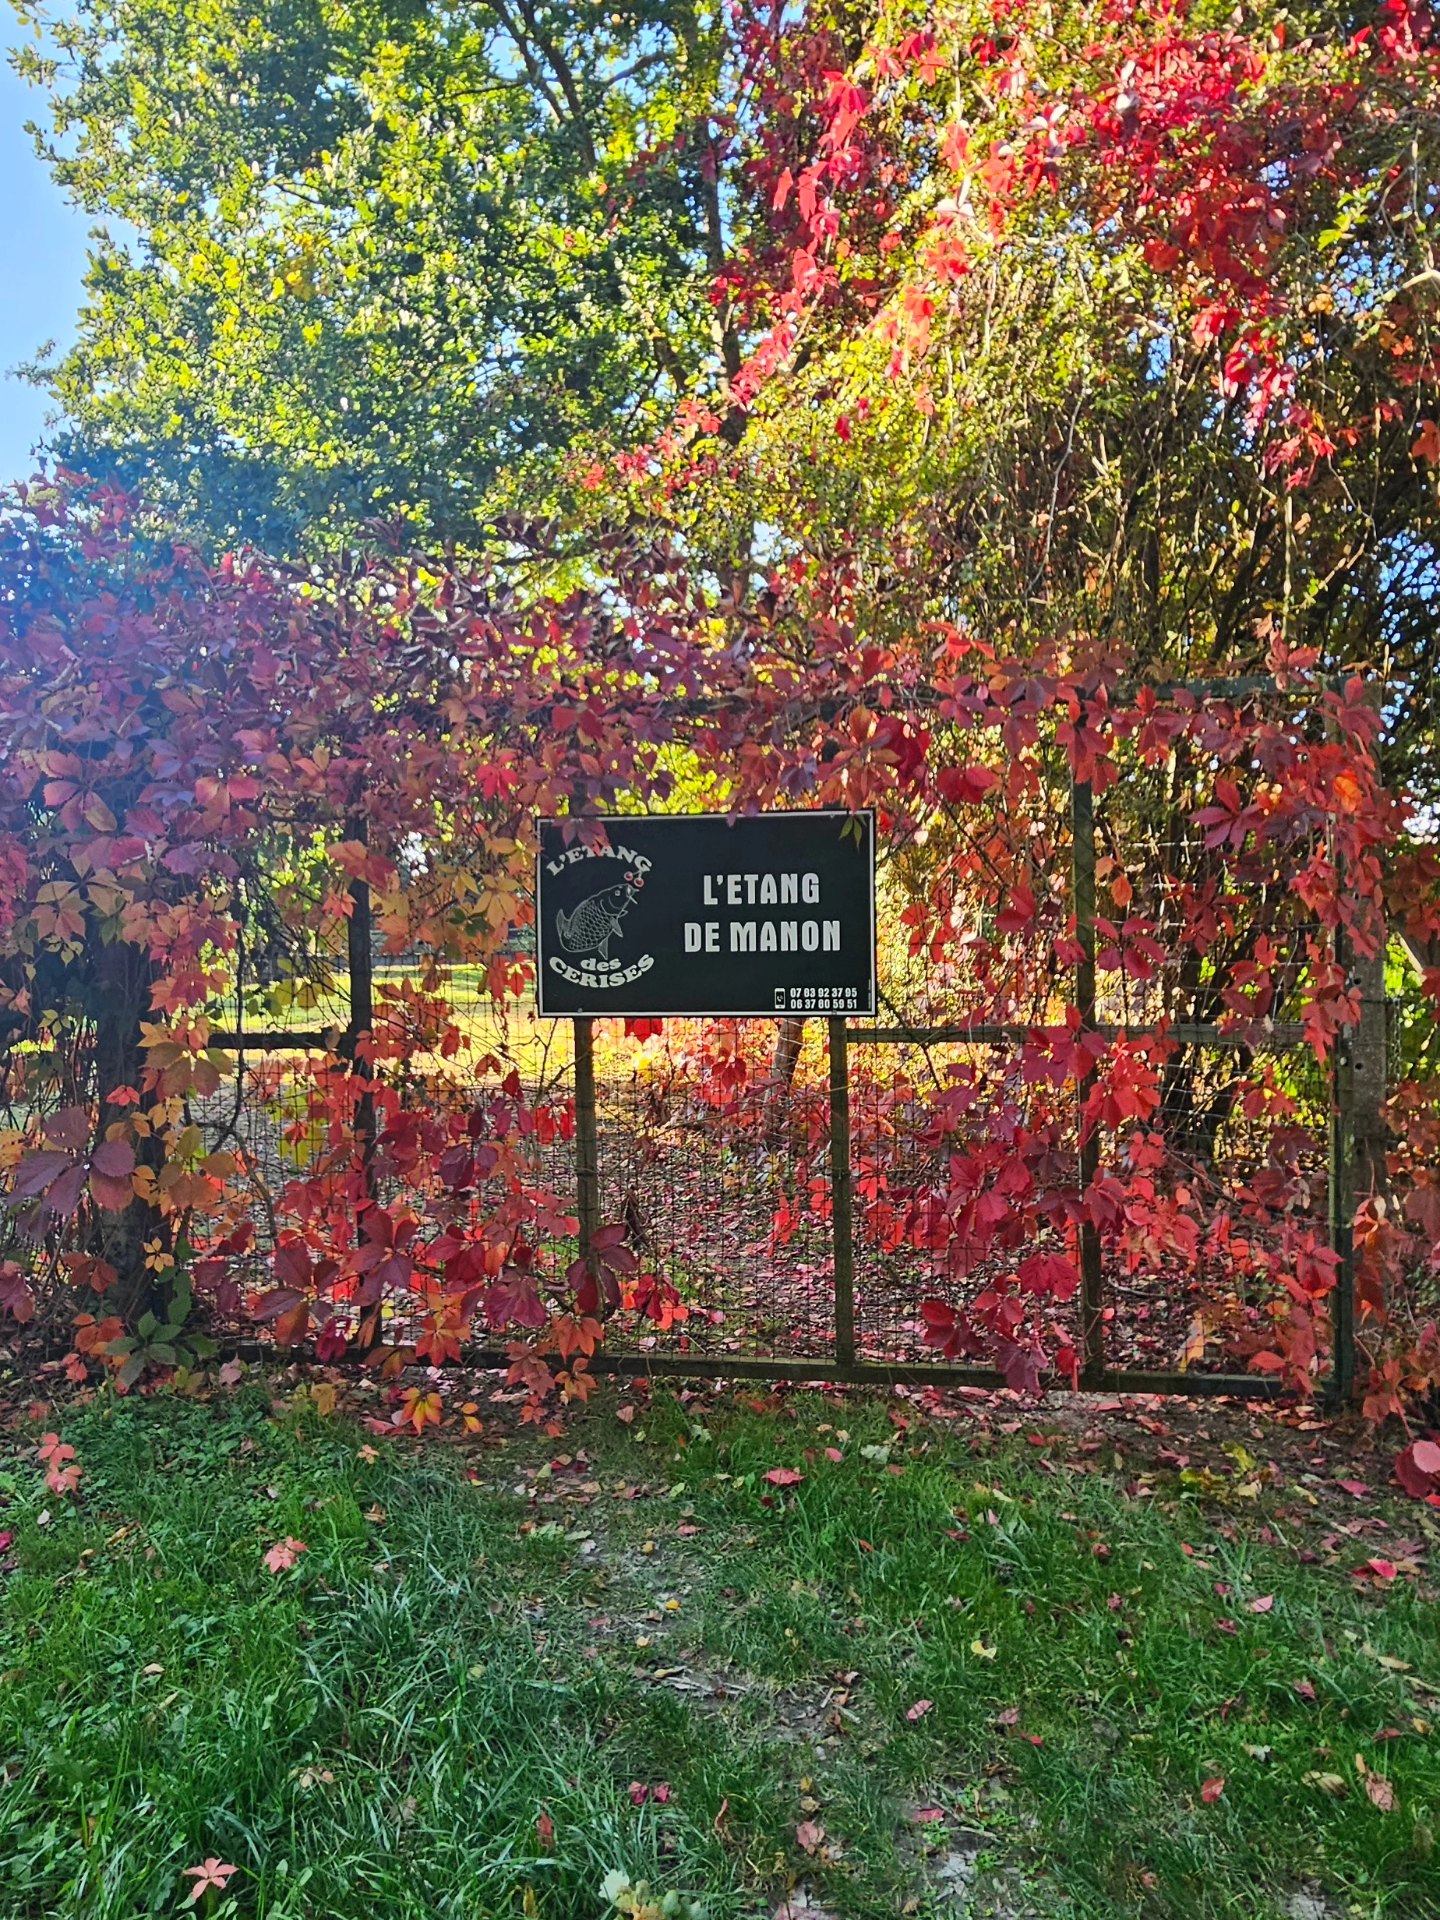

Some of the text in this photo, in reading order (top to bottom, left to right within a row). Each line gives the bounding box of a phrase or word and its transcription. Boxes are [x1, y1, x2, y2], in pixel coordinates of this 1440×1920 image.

[703, 872, 820, 905] L'ETANG
[684, 919, 842, 953] DE MANON
[549, 954, 655, 988] CERISES
[580, 957, 621, 972] des
[790, 987, 802, 998] 07
[817, 987, 830, 998] 92
[831, 987, 843, 998] 37
[844, 987, 858, 998] 95
[790, 999, 803, 1009] 06
[804, 999, 817, 1009] 37
[832, 999, 845, 1009] 59
[846, 999, 857, 1009] 51
